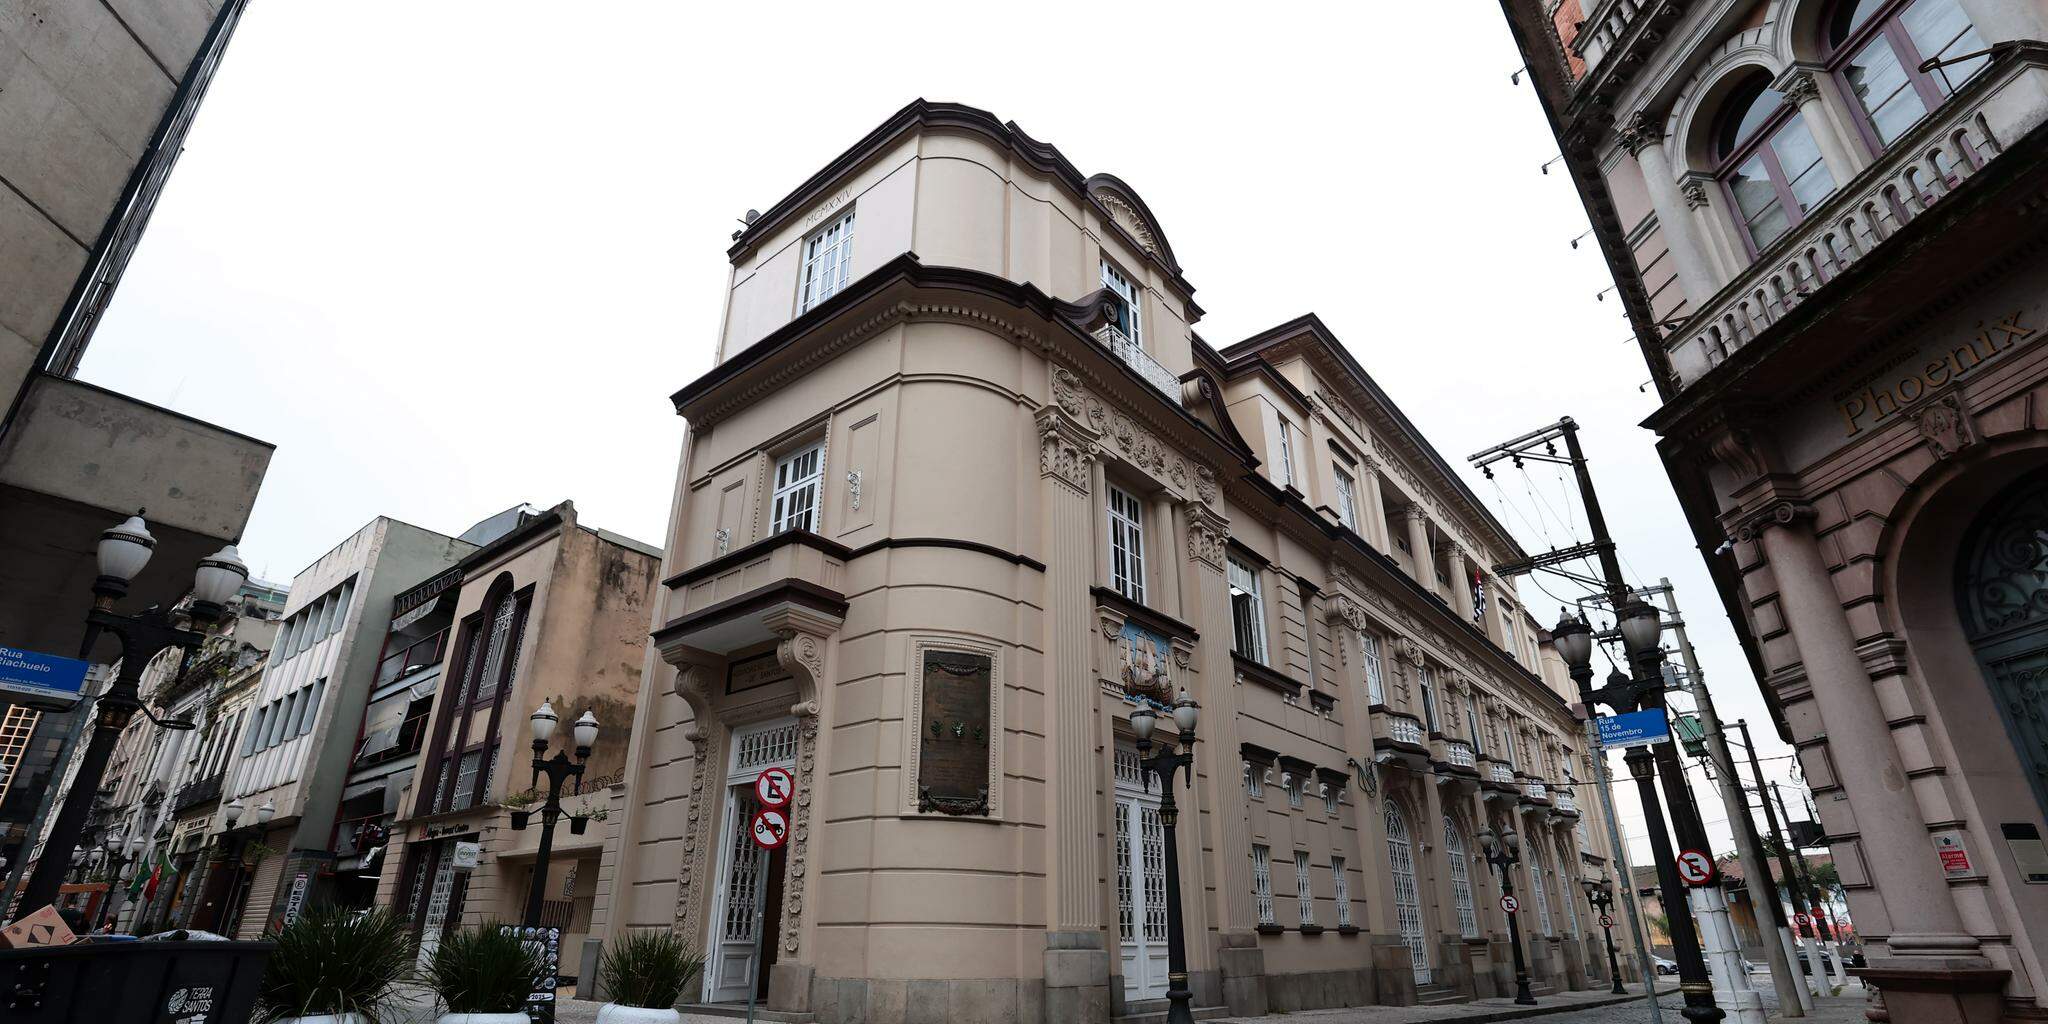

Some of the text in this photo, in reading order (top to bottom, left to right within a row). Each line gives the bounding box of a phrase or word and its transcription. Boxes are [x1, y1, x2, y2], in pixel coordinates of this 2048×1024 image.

[805, 186, 853, 226] MCMXXIV
[1839, 311, 2037, 438] Phoenix
[0, 648, 23, 659] Rua
[1602, 728, 1643, 739] Novembro
[768, 776, 782, 798] E
[1687, 858, 1700, 876] E
[190, 987, 213, 999] TERRA
[182, 1000, 212, 1012] SANTOS
